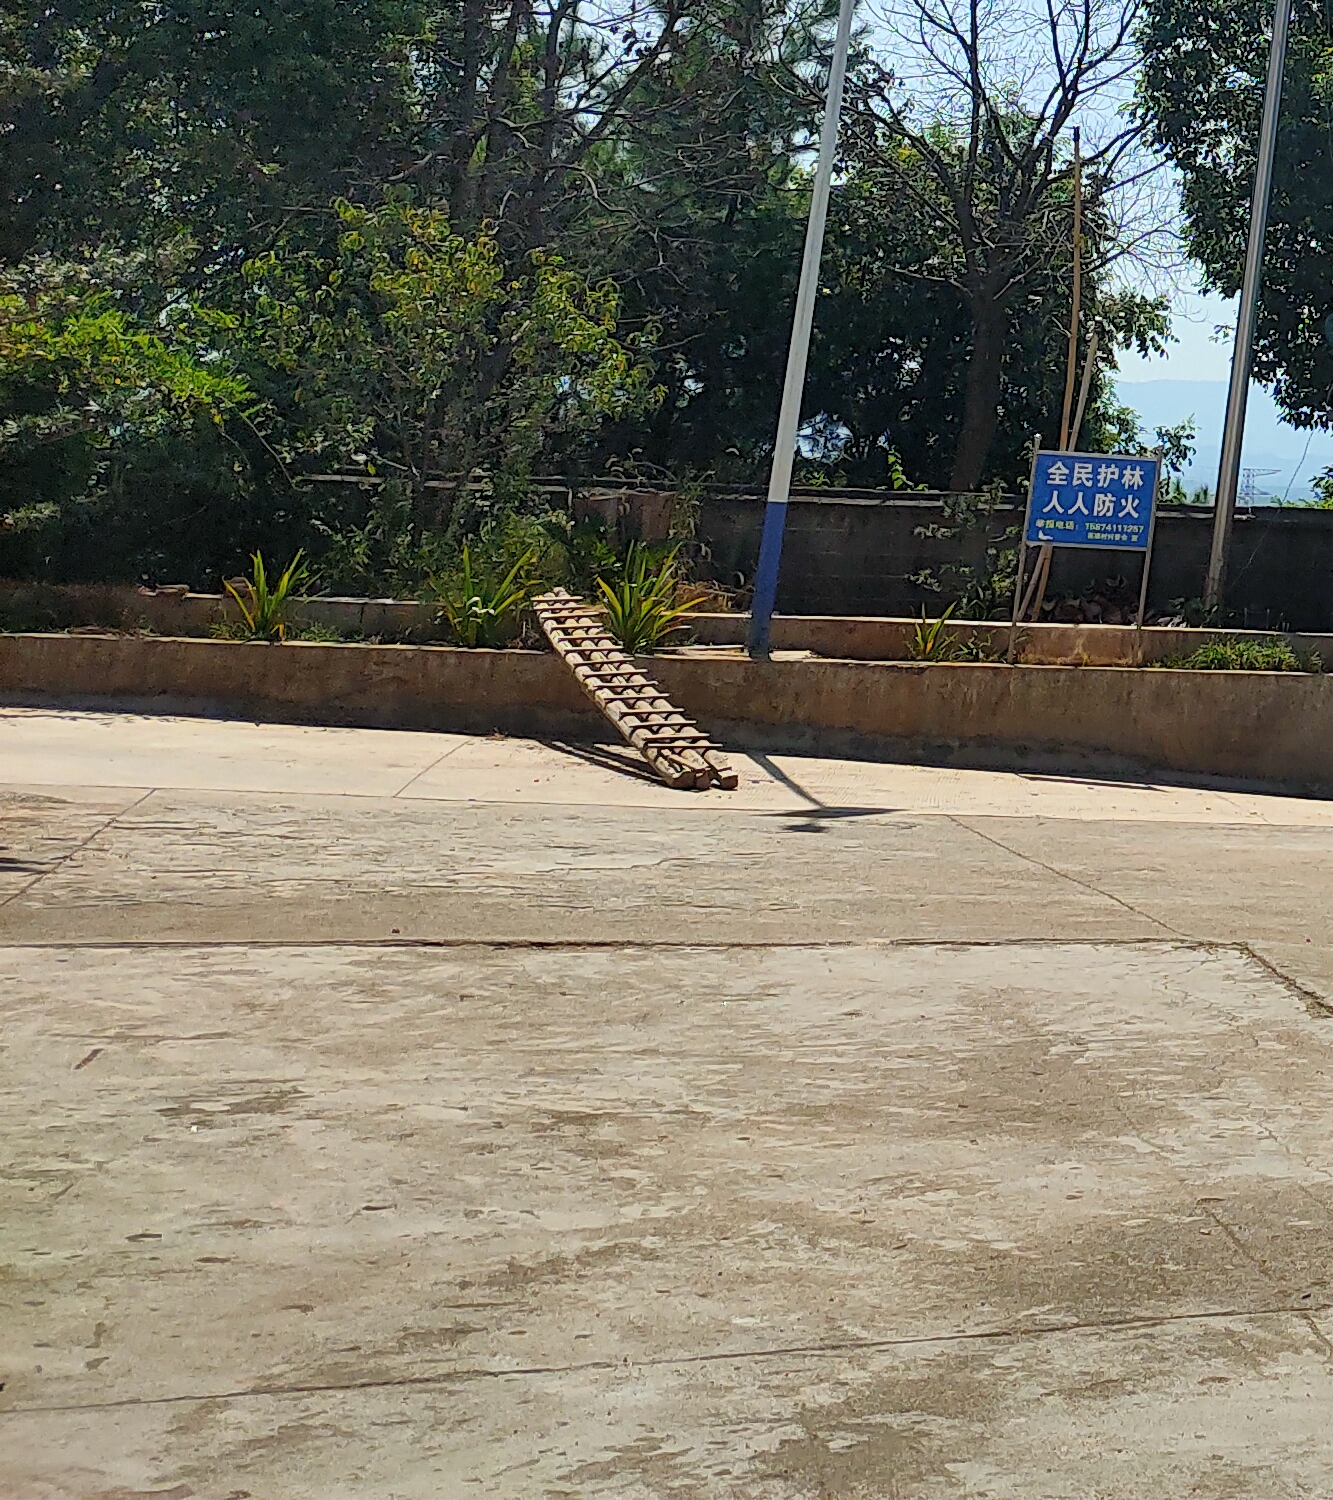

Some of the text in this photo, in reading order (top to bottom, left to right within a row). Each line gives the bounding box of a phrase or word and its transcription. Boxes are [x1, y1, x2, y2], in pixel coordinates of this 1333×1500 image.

[1046, 460, 1145, 491] 全民护林
[1042, 490, 1140, 519] 人人防火
